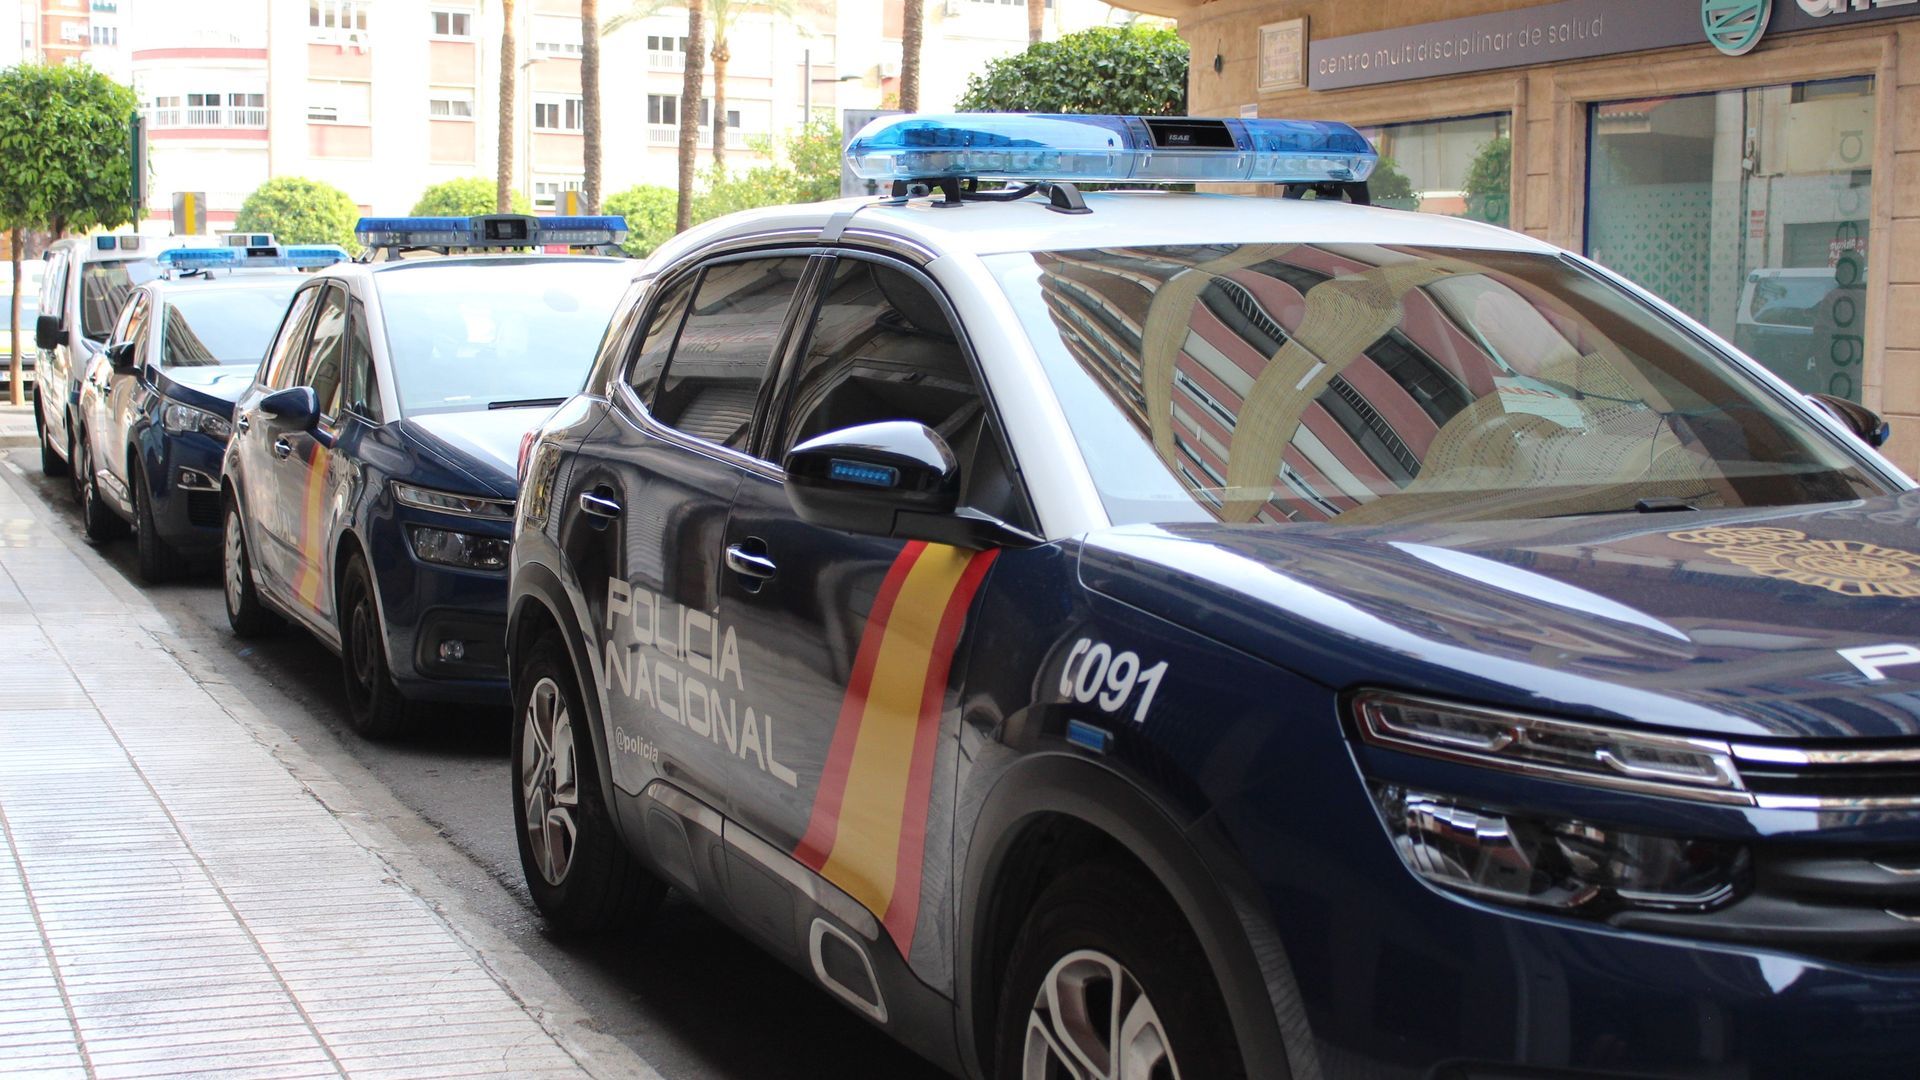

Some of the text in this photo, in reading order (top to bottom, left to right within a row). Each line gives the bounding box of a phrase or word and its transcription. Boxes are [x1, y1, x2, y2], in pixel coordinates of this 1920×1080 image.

[1319, 50, 1370, 75] centro
[1374, 31, 1512, 68] multidisciplinar
[1518, 24, 1542, 48] de
[1548, 13, 1604, 44] salud
[606, 576, 745, 692] POLICÍA
[605, 639, 798, 788] NACIONAL
[1075, 642, 1169, 723] 091
[615, 726, 659, 763] @policia
